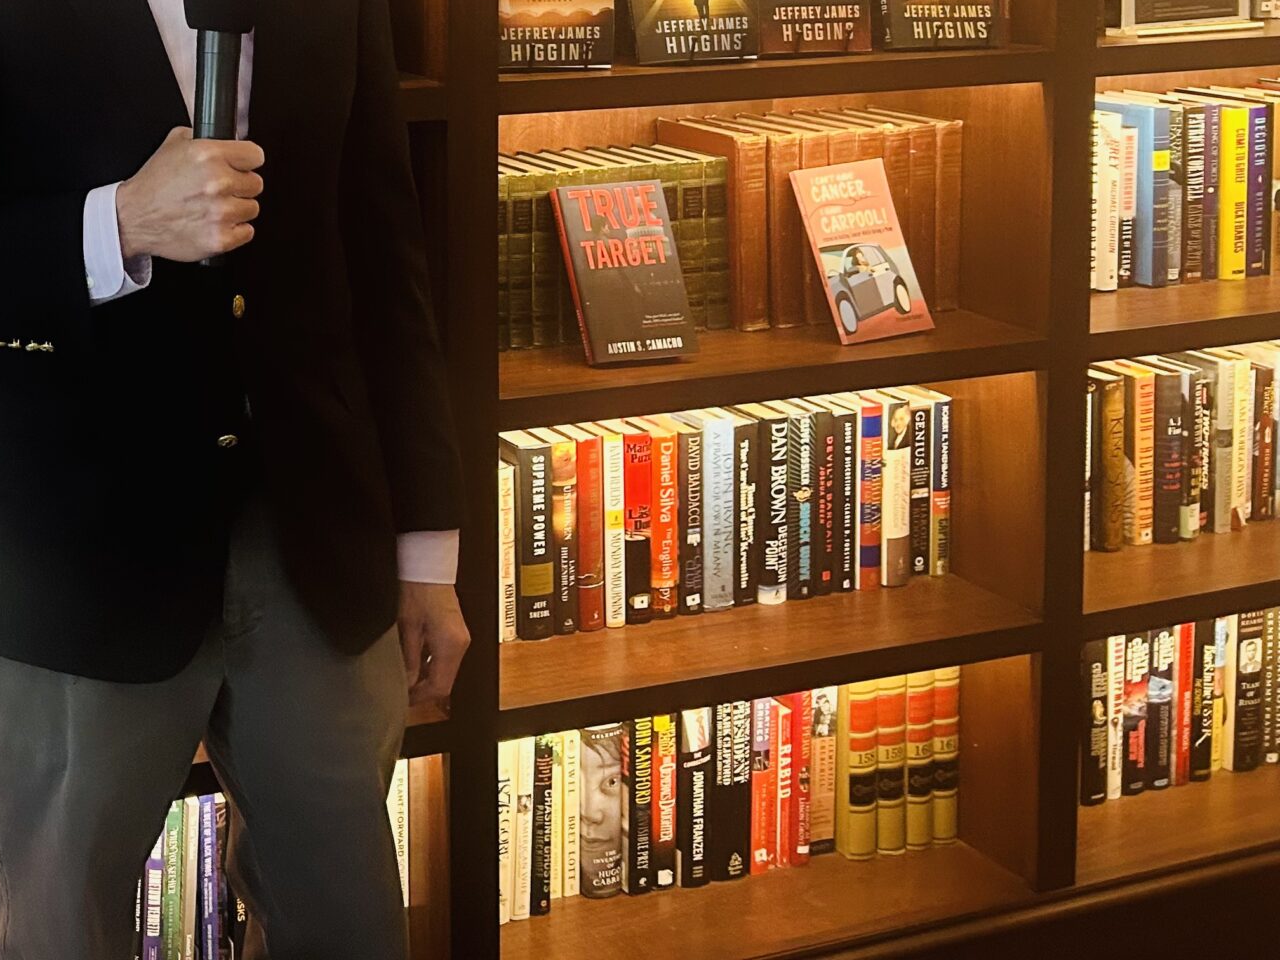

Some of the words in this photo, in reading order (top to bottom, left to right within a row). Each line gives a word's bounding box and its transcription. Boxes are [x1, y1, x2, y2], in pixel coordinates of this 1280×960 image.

[656, 18, 708, 33] JEFFREY
[711, 17, 748, 30] JAMES
[773, 6, 821, 20] JEFFREY
[824, 5, 860, 18] JAMES
[904, 5, 951, 17] JEFFREY
[953, 5, 991, 17] JAMES
[501, 27, 556, 40] JEFFREY
[559, 26, 600, 39] JAMES
[913, 22, 987, 39] HIGGINS
[568, 185, 663, 232] TRUE
[821, 208, 888, 234] CARPOOL!
[581, 235, 666, 269] TARGET
[608, 342, 635, 354] AUSTIN
[637, 341, 645, 351] S.
[647, 337, 683, 350] CAMACHO
[687, 437, 700, 474] DAVID
[771, 423, 788, 462] DAN
[659, 442, 672, 488] Daniel
[532, 455, 544, 515] SUPREME
[687, 475, 701, 528] BALDACCI
[771, 464, 787, 525] BROWN
[659, 489, 673, 523] Silva
[533, 518, 545, 556] POWER
[765, 540, 777, 571] POINT
[777, 525, 787, 583] DECEPTION
[635, 717, 651, 745] JOHN
[635, 746, 651, 806] SANDFORD
[779, 744, 792, 799] RABID
[693, 771, 704, 812] JONATHAN
[693, 813, 704, 861] FRANZEN
